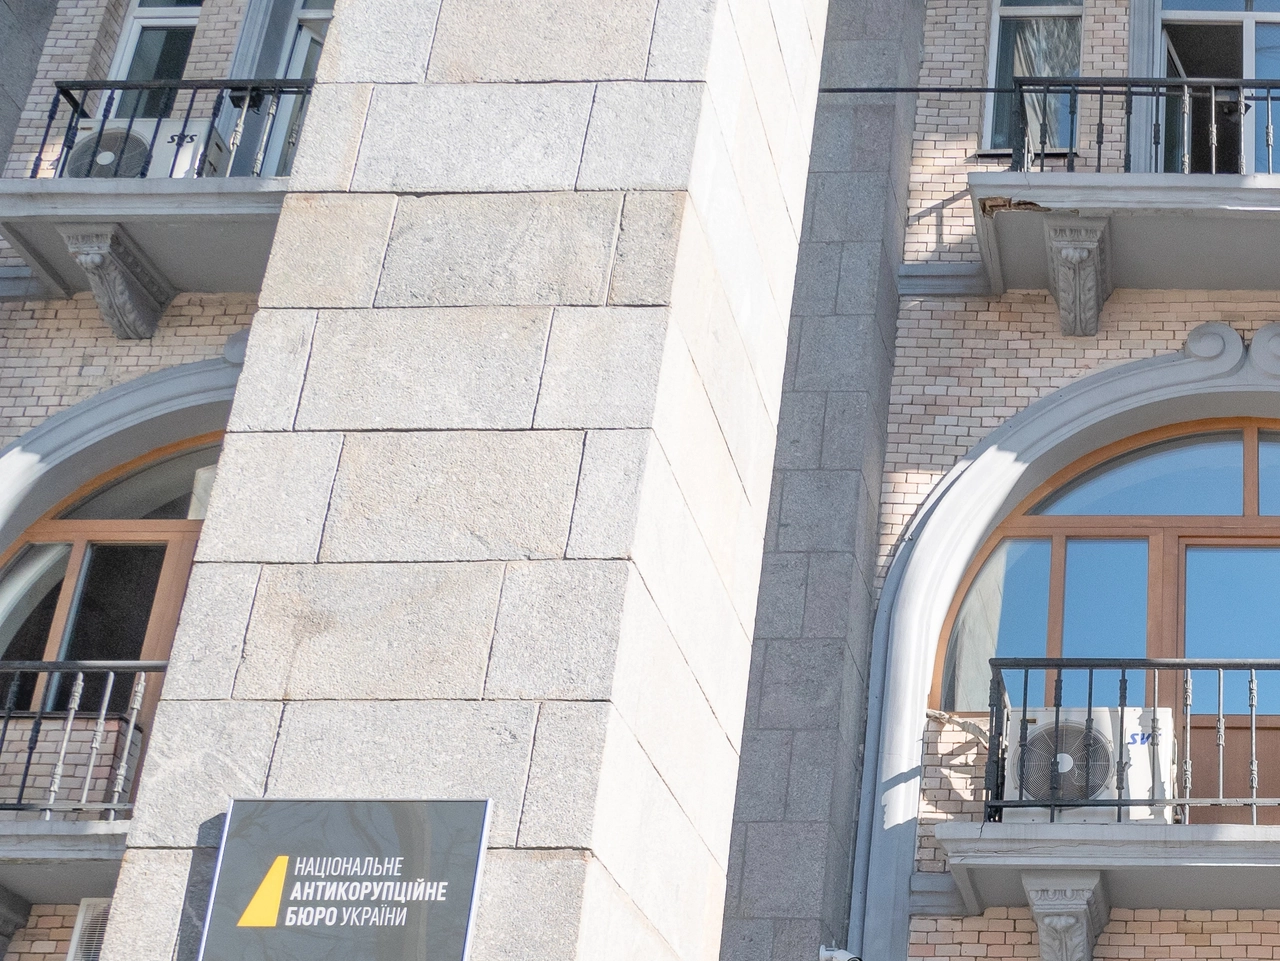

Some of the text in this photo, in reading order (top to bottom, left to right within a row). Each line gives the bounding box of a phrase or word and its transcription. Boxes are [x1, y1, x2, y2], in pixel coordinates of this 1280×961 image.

[167, 134, 198, 144] SS
[1127, 733, 1162, 745] SV
[294, 857, 404, 878] НАЦІОНАЛЬНЕ
[290, 879, 448, 903] АНТИКОРУПЦІЙНЕ
[285, 904, 408, 926] БЮРО УКРАЇНИ
